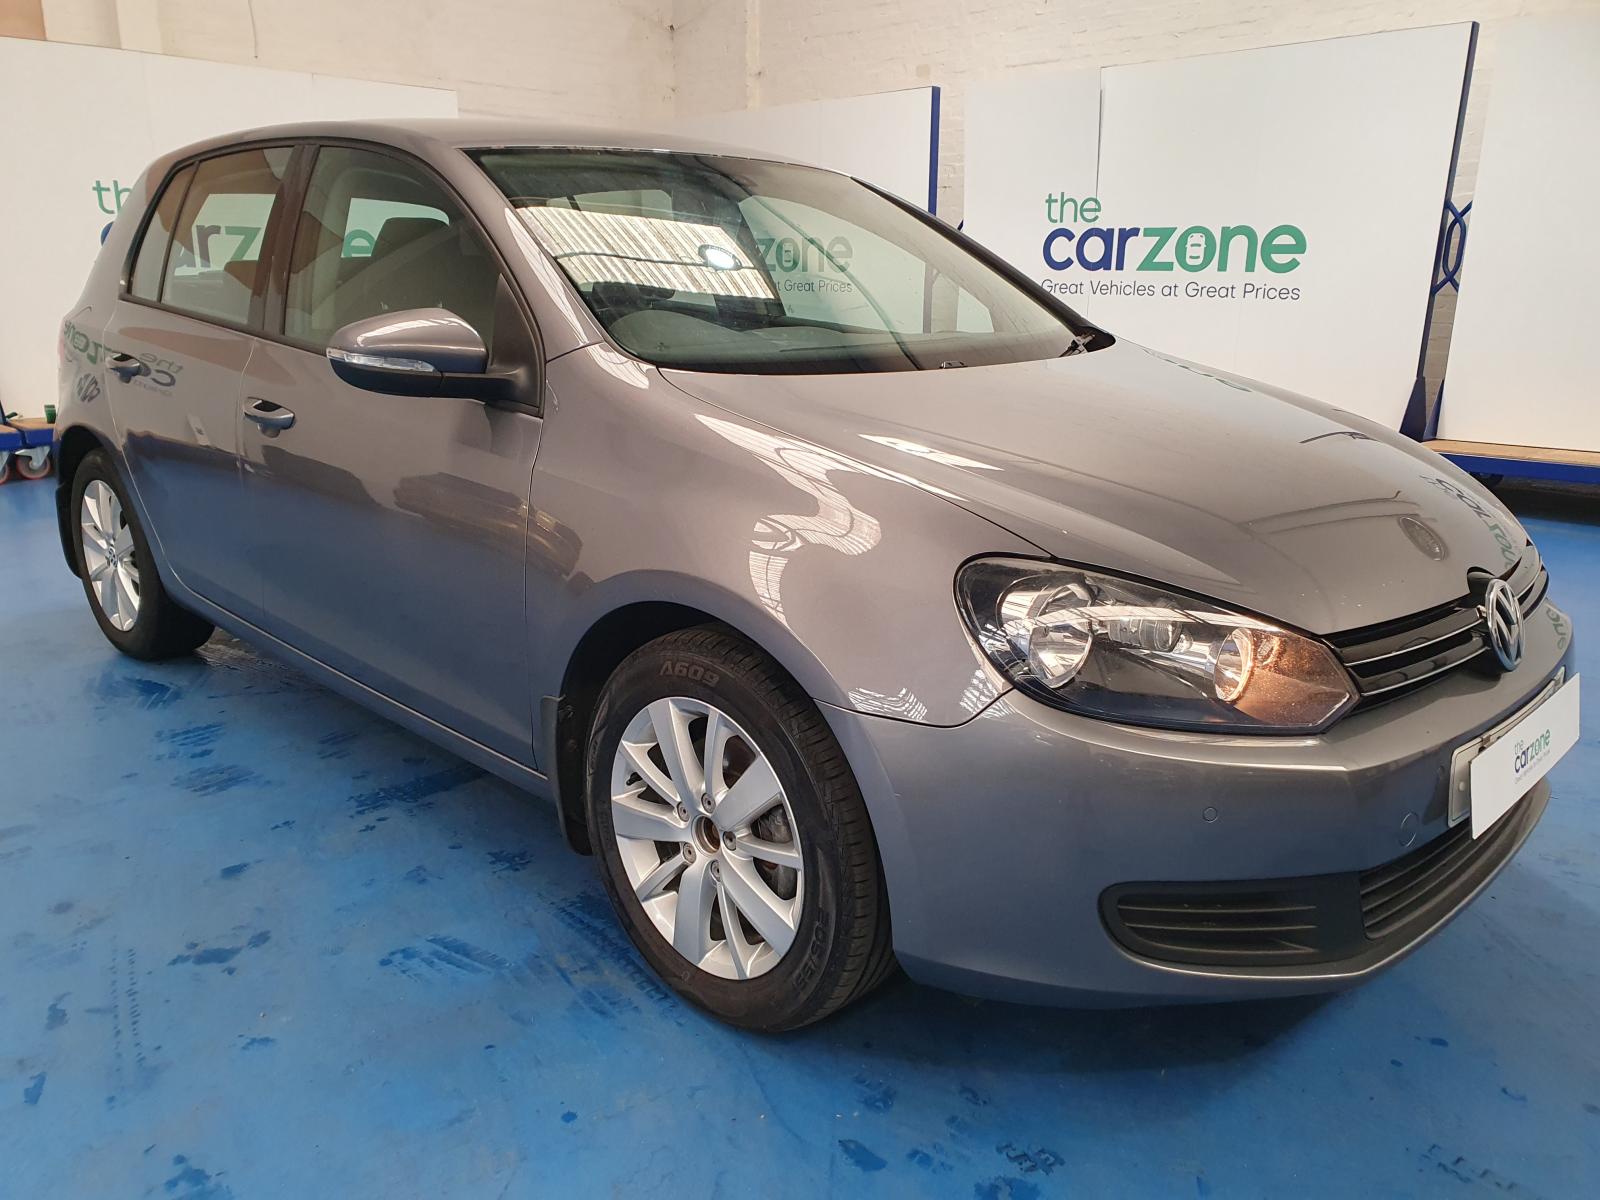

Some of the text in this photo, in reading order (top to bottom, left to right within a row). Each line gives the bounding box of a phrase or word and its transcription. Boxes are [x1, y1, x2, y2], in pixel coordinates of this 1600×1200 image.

[92, 180, 132, 215] th
[1045, 192, 1102, 224] the
[757, 236, 853, 273] zone
[1042, 224, 1307, 274] carzone
[784, 279, 815, 292] Great
[818, 280, 853, 293] Prices
[1041, 278, 1301, 300] Great Vehicles at Great Prices
[660, 660, 719, 688] A609
[1514, 729, 1551, 774] carzone
